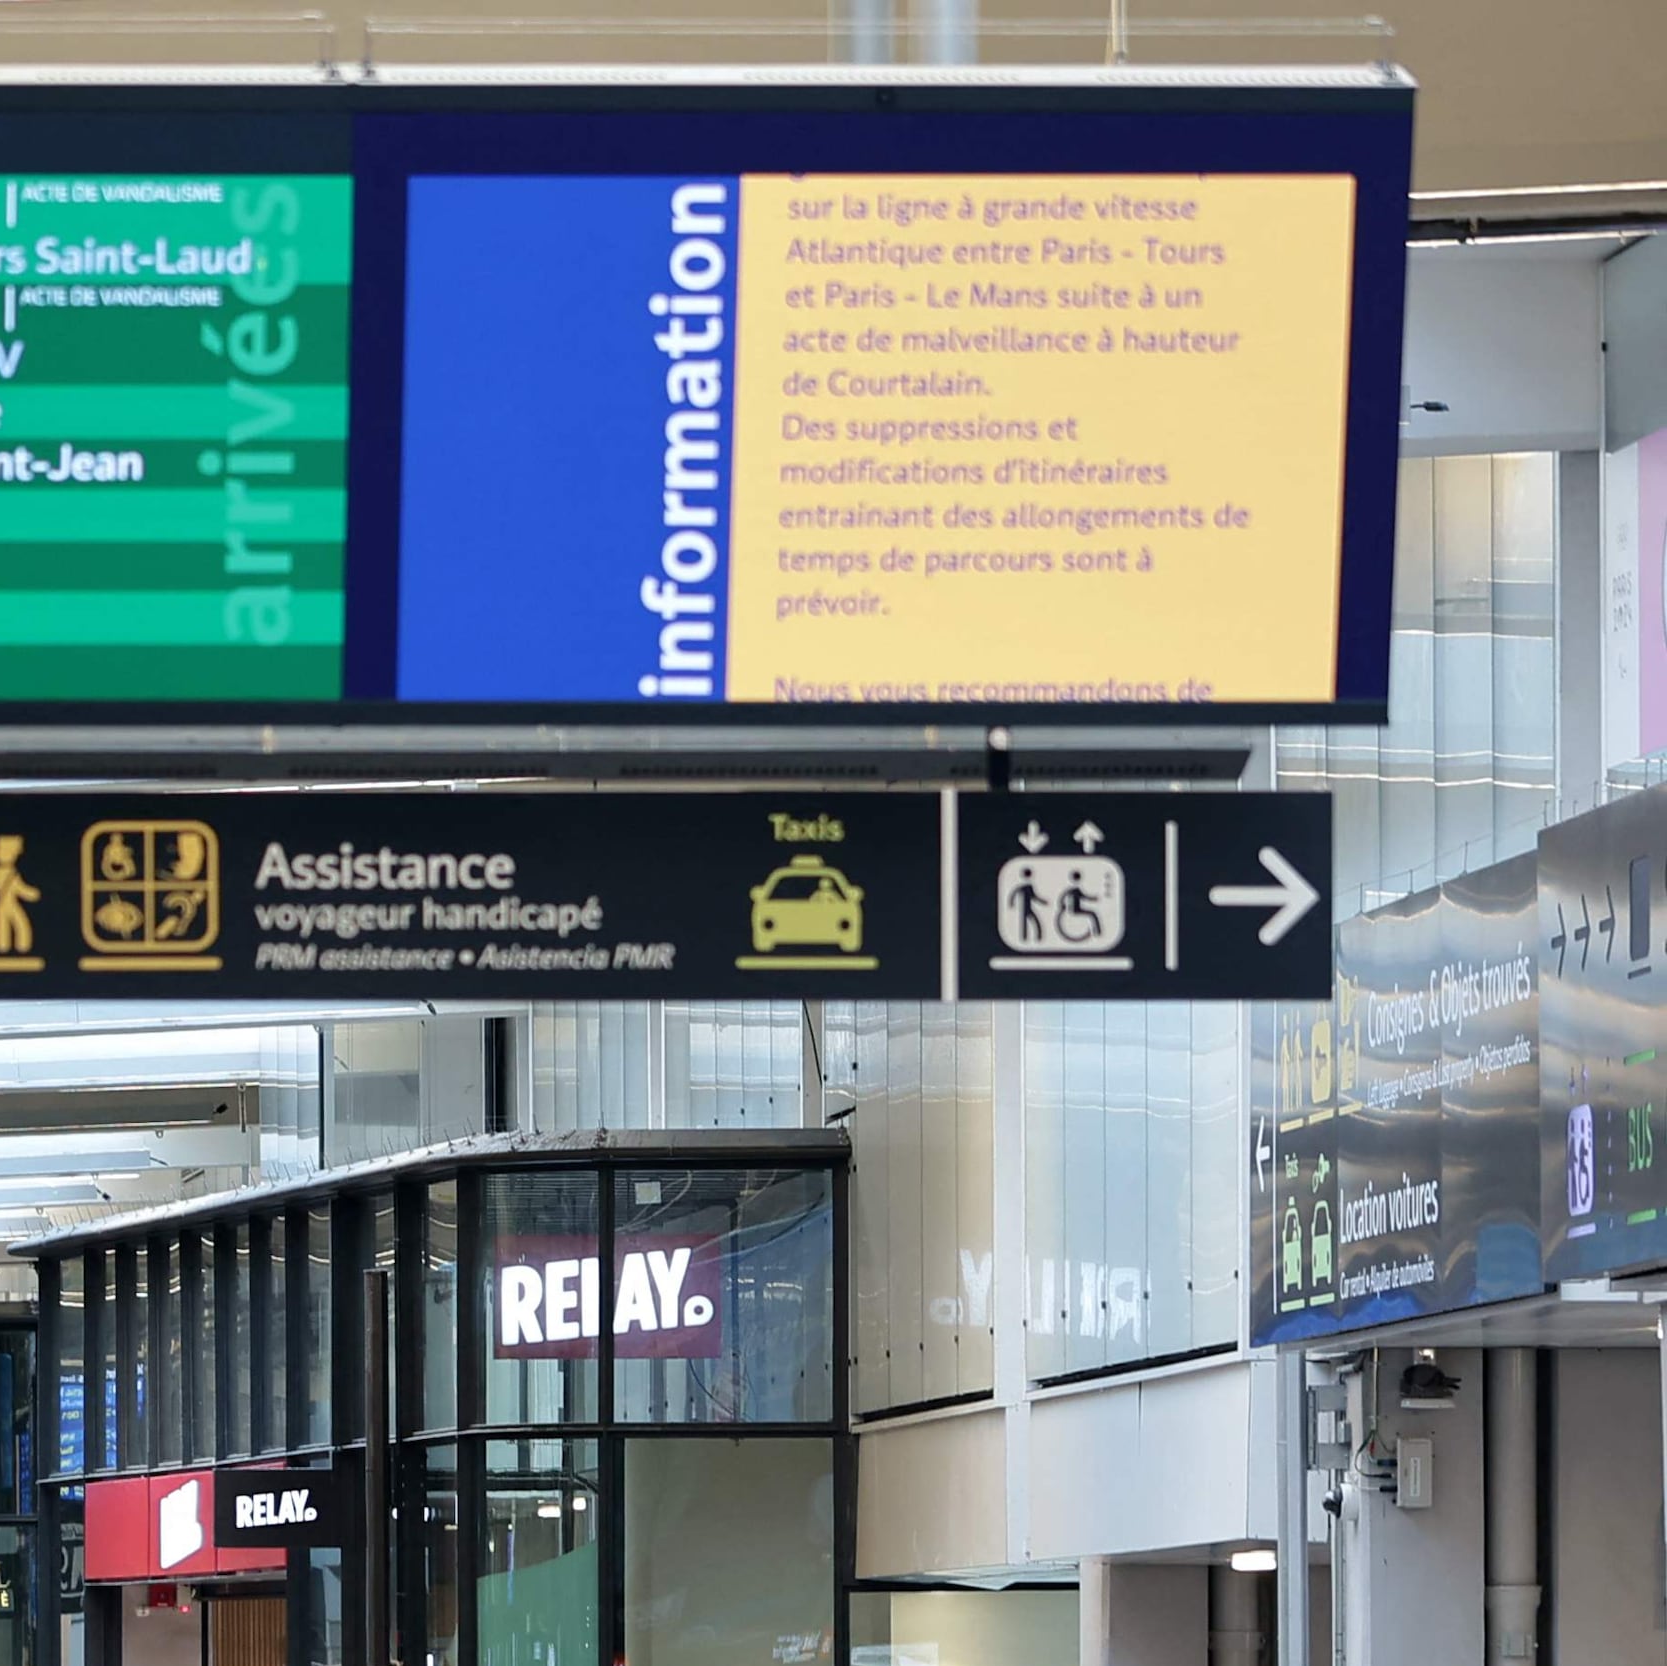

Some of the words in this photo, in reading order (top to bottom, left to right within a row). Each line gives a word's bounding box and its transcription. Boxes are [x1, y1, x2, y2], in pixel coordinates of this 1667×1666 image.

[788, 197, 832, 219] sur
[842, 194, 868, 219] la
[876, 194, 950, 227] ligne
[983, 194, 1087, 227] grande
[1094, 194, 1195, 219] vitesse
[36, 237, 252, 276] Saint-Laud
[197, 184, 300, 646] arrivées
[640, 182, 726, 697] information
[770, 813, 844, 843] Taxis
[255, 842, 515, 890] Assistance
[255, 900, 415, 938] voyageur
[423, 897, 603, 938] handicapé
[1367, 983, 1424, 1055] Consignes
[1441, 963, 1480, 1038] Objets
[1483, 941, 1530, 1011] trouvés
[1628, 1104, 1653, 1172] BUS
[1340, 1181, 1387, 1245] Location
[1389, 1172, 1439, 1233] voitures
[236, 1489, 309, 1528] RELAY
